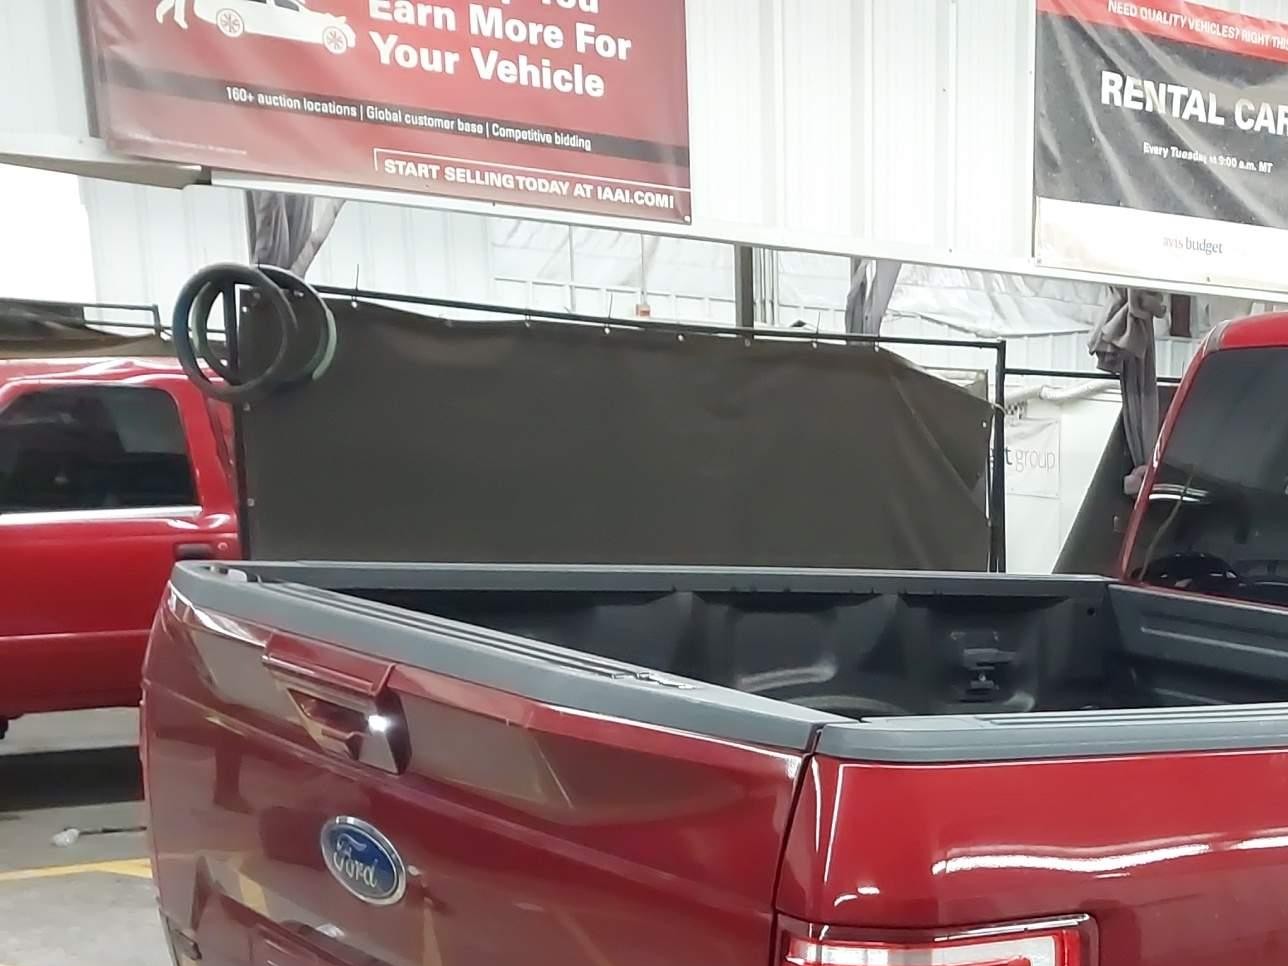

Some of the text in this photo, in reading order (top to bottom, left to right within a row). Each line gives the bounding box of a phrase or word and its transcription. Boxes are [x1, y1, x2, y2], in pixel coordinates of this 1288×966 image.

[369, 0, 632, 61] Earn More For
[1107, 0, 1137, 17] NEED
[1140, 8, 1187, 28] QUALITY
[1188, 16, 1240, 40] VEHICLES?
[1241, 30, 1270, 47] RIGHT
[368, 31, 606, 97] Your Vehicle
[225, 86, 254, 102] 160+
[257, 92, 301, 109] auction
[303, 97, 357, 117] locations
[366, 105, 402, 123] Global
[404, 112, 455, 130] customer
[457, 118, 483, 135] base
[492, 123, 552, 143] Competitive
[554, 131, 592, 151] bidding
[1101, 70, 1225, 126] RENTAL
[384, 159, 440, 180] START
[444, 166, 514, 189] SELLING
[515, 175, 570, 195] TODAY
[573, 184, 593, 200] AT
[1143, 141, 1168, 158] Every
[1170, 145, 1207, 164] Tuesday
[1219, 155, 1237, 168] 9:00
[1239, 160, 1257, 171] a.m.
[1258, 161, 1273, 174] MT
[1163, 235, 1223, 255] avis budget
[1015, 449, 1056, 473] group
[333, 832, 378, 888] Ford
